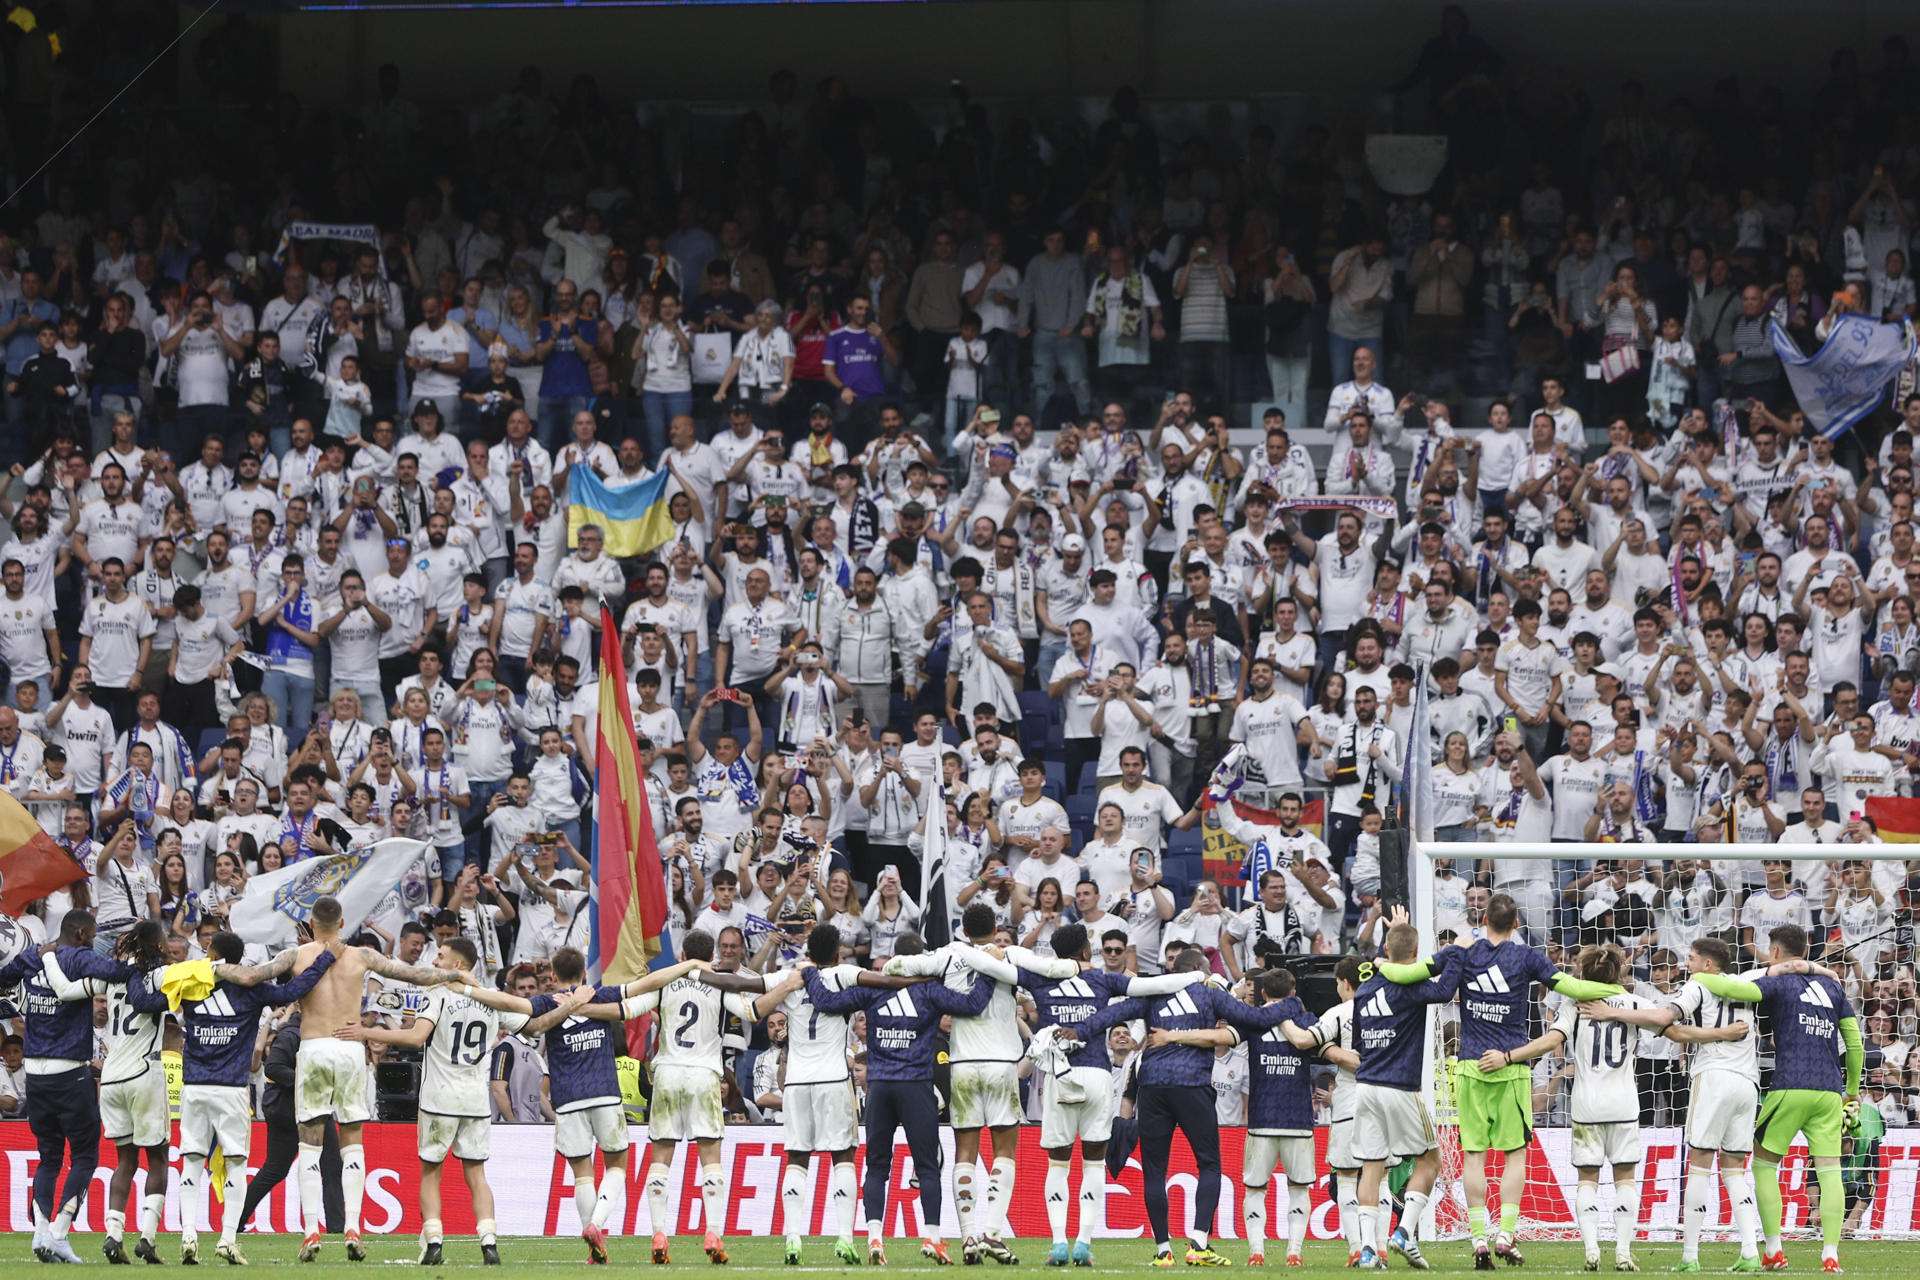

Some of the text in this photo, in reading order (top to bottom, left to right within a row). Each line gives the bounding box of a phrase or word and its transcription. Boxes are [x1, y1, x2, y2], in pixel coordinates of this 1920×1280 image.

[67, 730, 98, 742] bwin
[111, 992, 140, 1036] 12
[1051, 1005, 1097, 1017] Emirates
[1466, 1001, 1511, 1015] Emirates
[676, 1001, 699, 1048] 2
[1059, 1014, 1069, 1023] FLY
[194, 1025, 238, 1037] Emirates
[563, 1028, 606, 1046] Emirates
[876, 1028, 917, 1041] Emirates
[209, 1036, 231, 1046] BETTER
[450, 1020, 487, 1065] 19
[572, 1040, 602, 1052] FLY BETTER
[880, 1039, 911, 1049] FLY BETTER
[1589, 1020, 1628, 1069] 10
[1260, 1054, 1302, 1067] Emirates
[1266, 1065, 1297, 1076] FLY BETTER
[167, 1073, 175, 1084] 8
